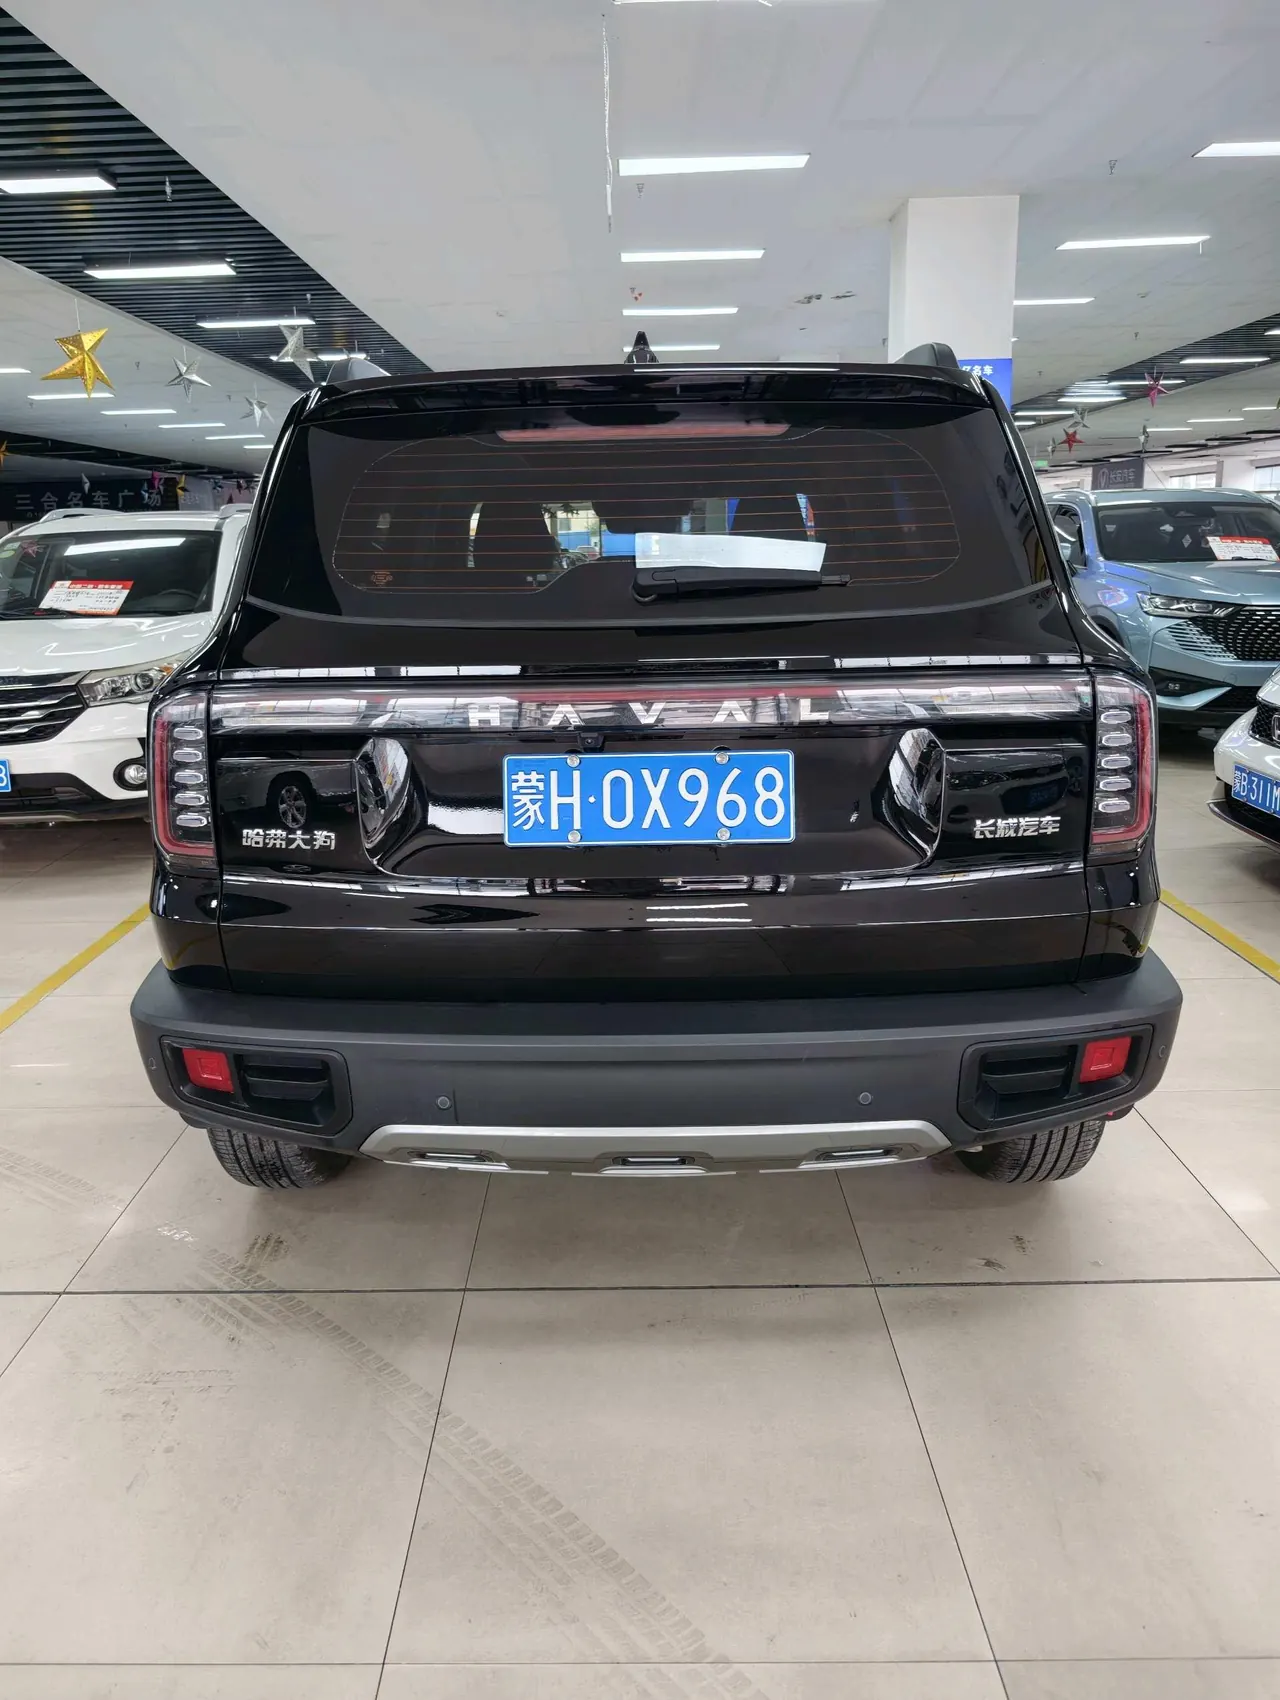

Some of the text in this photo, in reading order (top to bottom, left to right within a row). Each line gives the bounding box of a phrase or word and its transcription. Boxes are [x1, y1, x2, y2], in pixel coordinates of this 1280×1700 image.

[468, 697, 829, 727] HAVAL
[242, 828, 336, 850] 哈弗大狗
[973, 815, 1062, 839] 长城汽车
